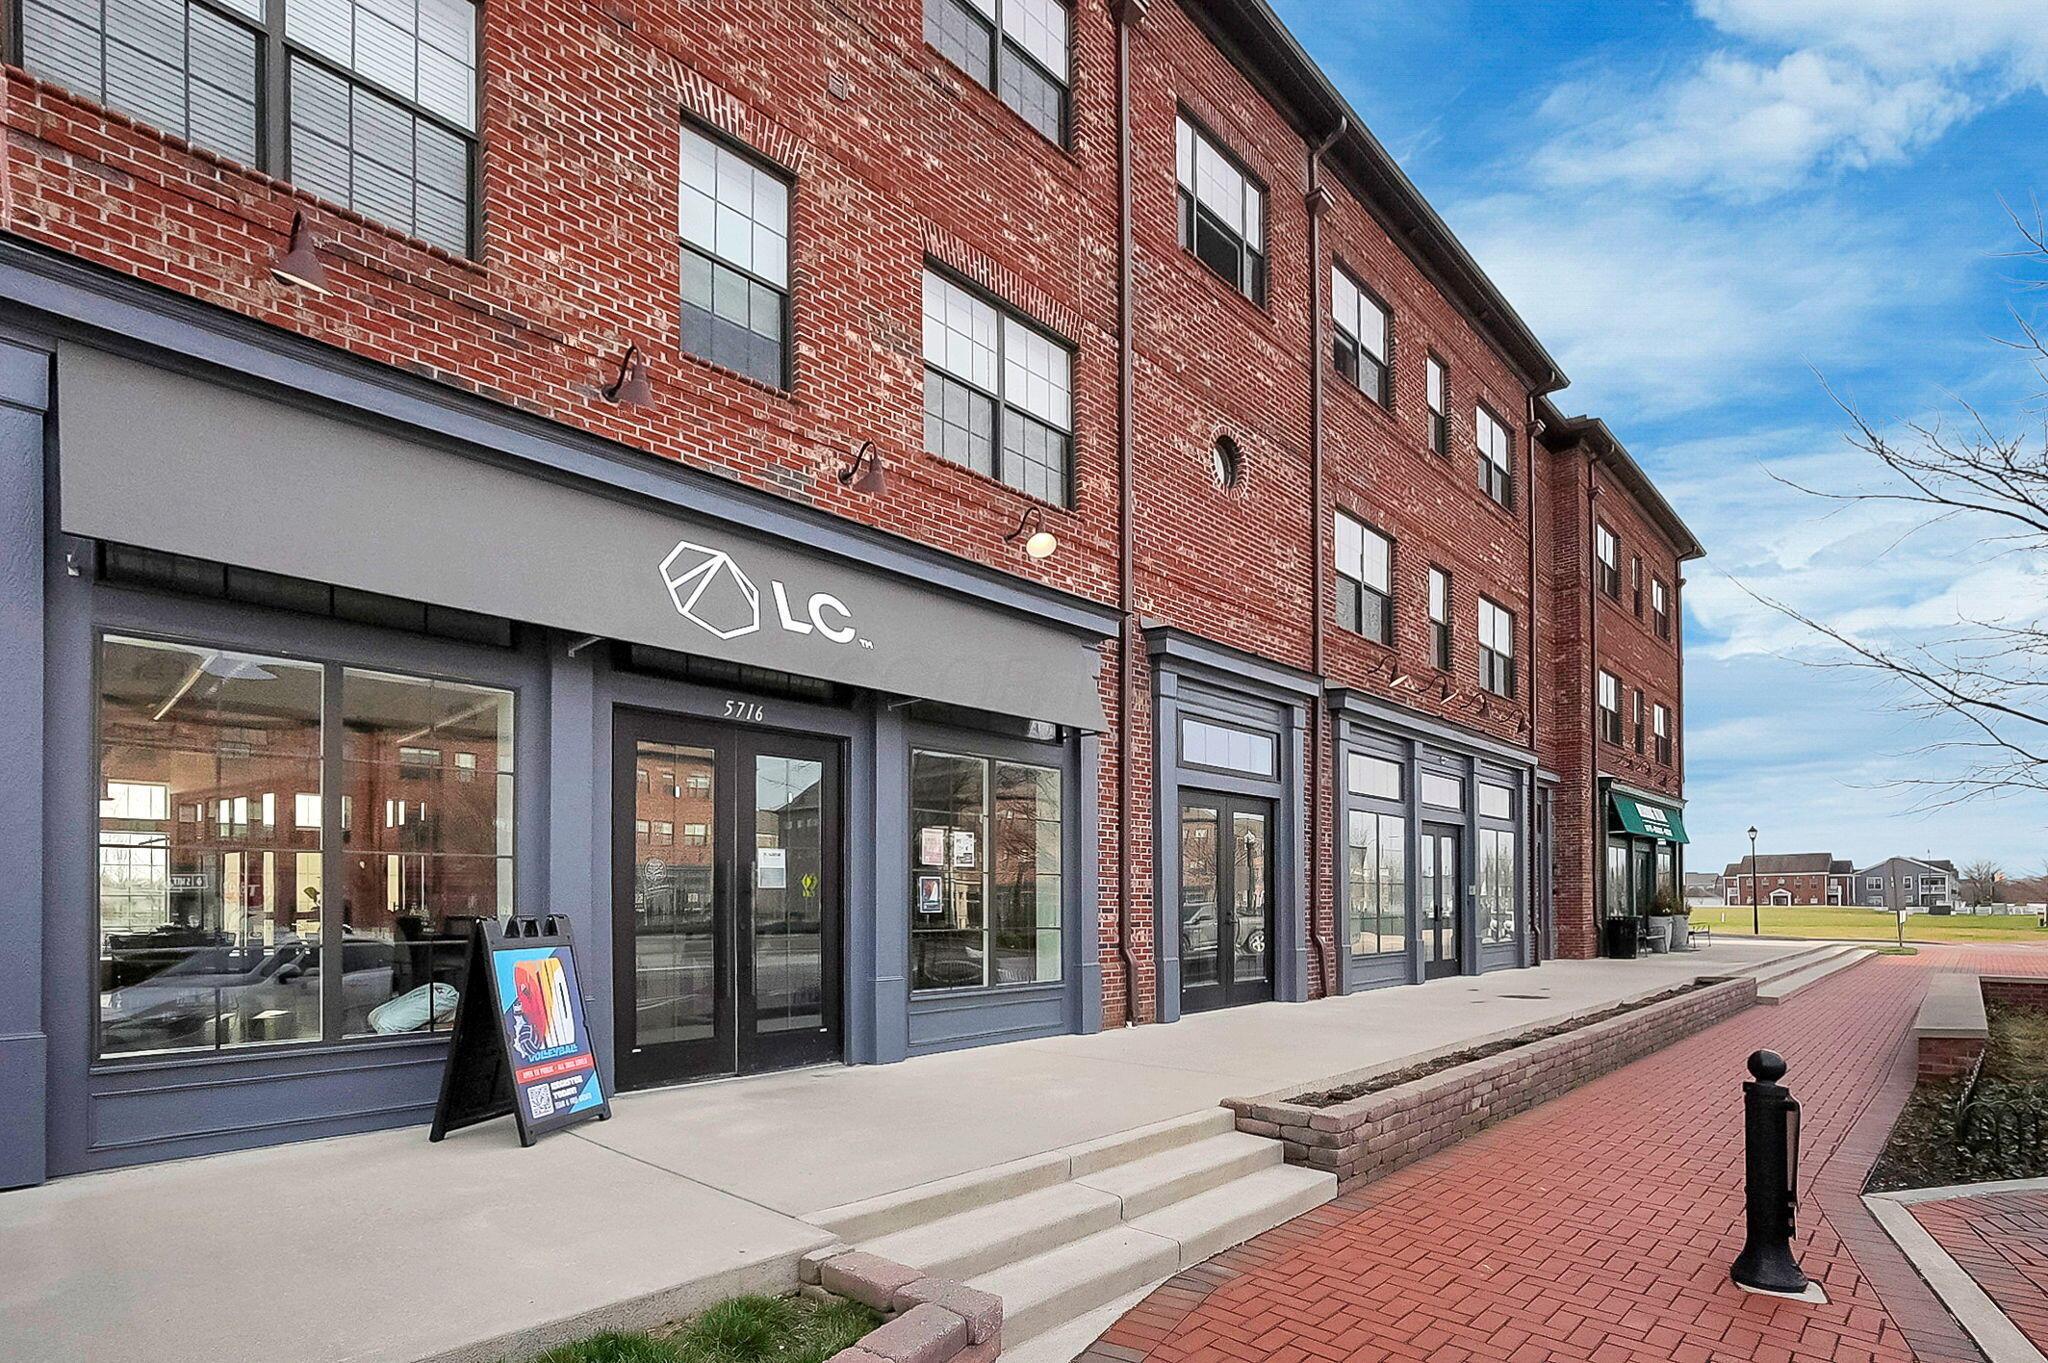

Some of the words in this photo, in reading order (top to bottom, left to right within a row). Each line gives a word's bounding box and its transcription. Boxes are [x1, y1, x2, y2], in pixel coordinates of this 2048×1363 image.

[771, 580, 856, 644] LC
[723, 700, 763, 721] 5716
[528, 1043, 578, 1062] VOLLEYBALL
